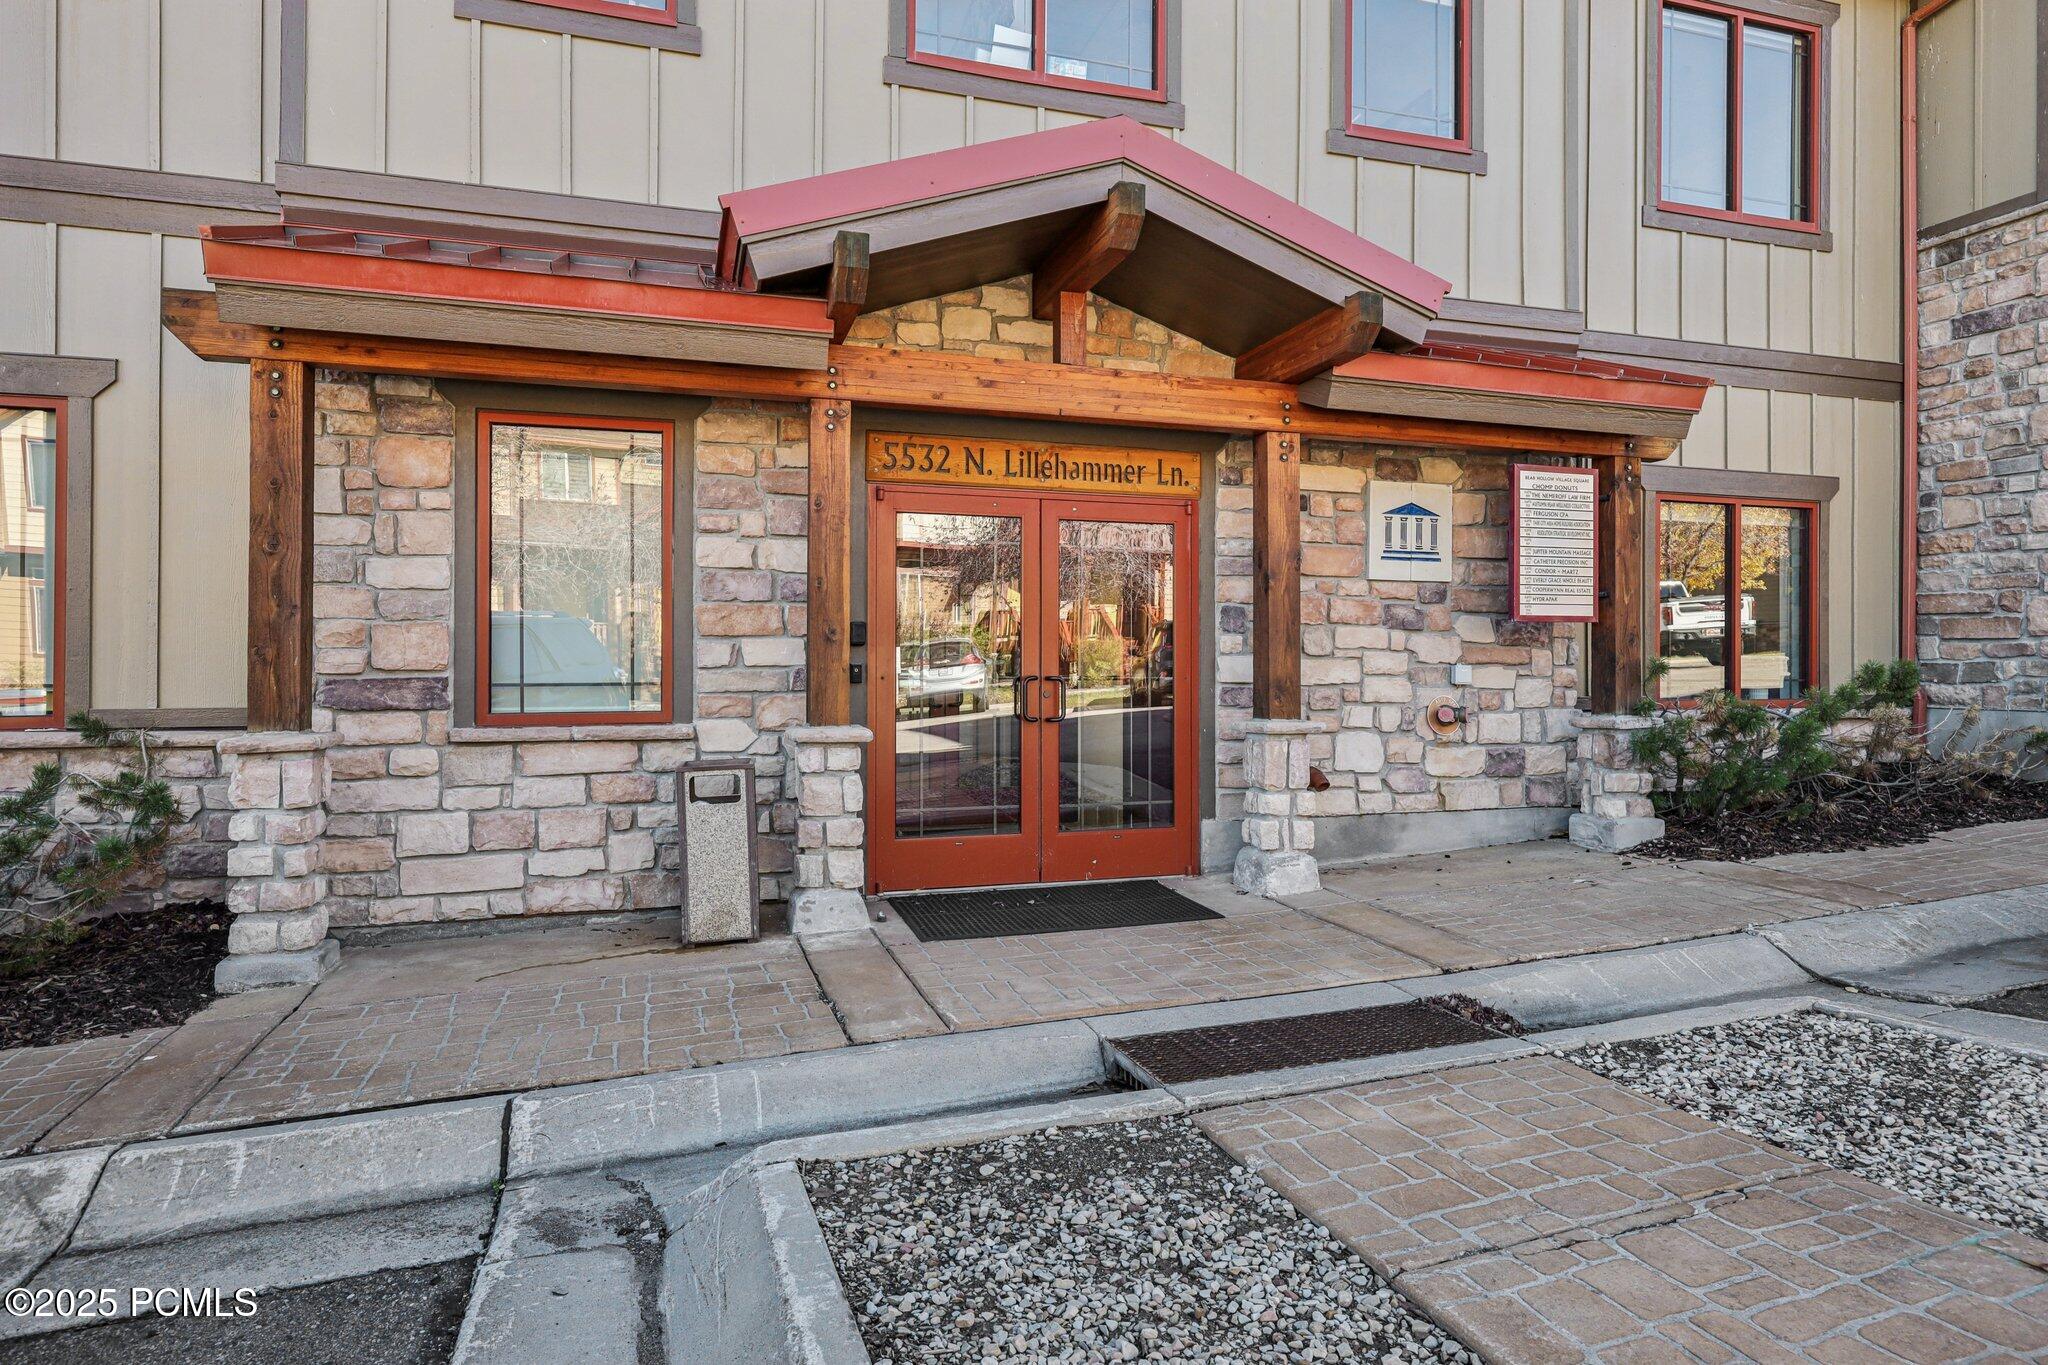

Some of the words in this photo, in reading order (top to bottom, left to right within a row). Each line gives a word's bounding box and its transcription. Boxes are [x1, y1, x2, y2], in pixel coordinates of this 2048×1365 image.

[882, 441, 951, 474] 5532
[964, 446, 993, 476] N.
[1004, 449, 1146, 485] Lillehammer
[1157, 458, 1190, 488] Ln.
